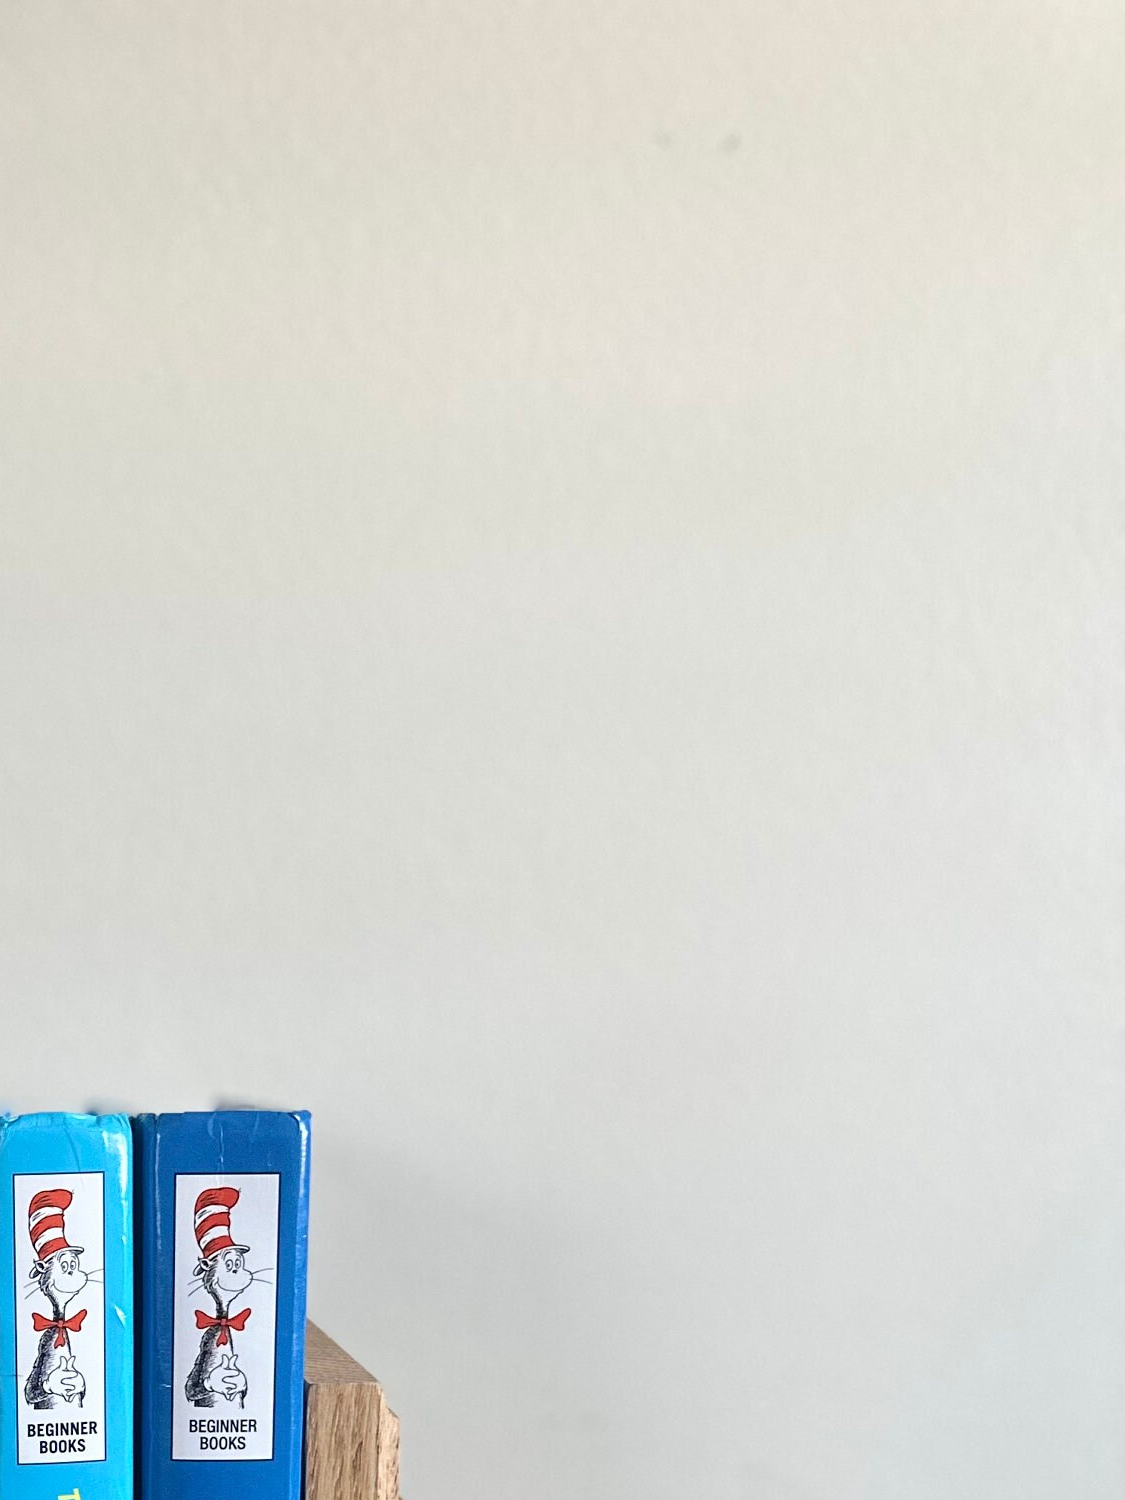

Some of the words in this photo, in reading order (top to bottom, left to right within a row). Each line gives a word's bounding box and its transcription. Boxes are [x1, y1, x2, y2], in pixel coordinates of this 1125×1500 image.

[27, 1421, 98, 1438] BEGINNER
[189, 1419, 257, 1433] BEGINNER
[39, 1439, 86, 1454] BOOKS
[199, 1436, 246, 1450] BOOKS
